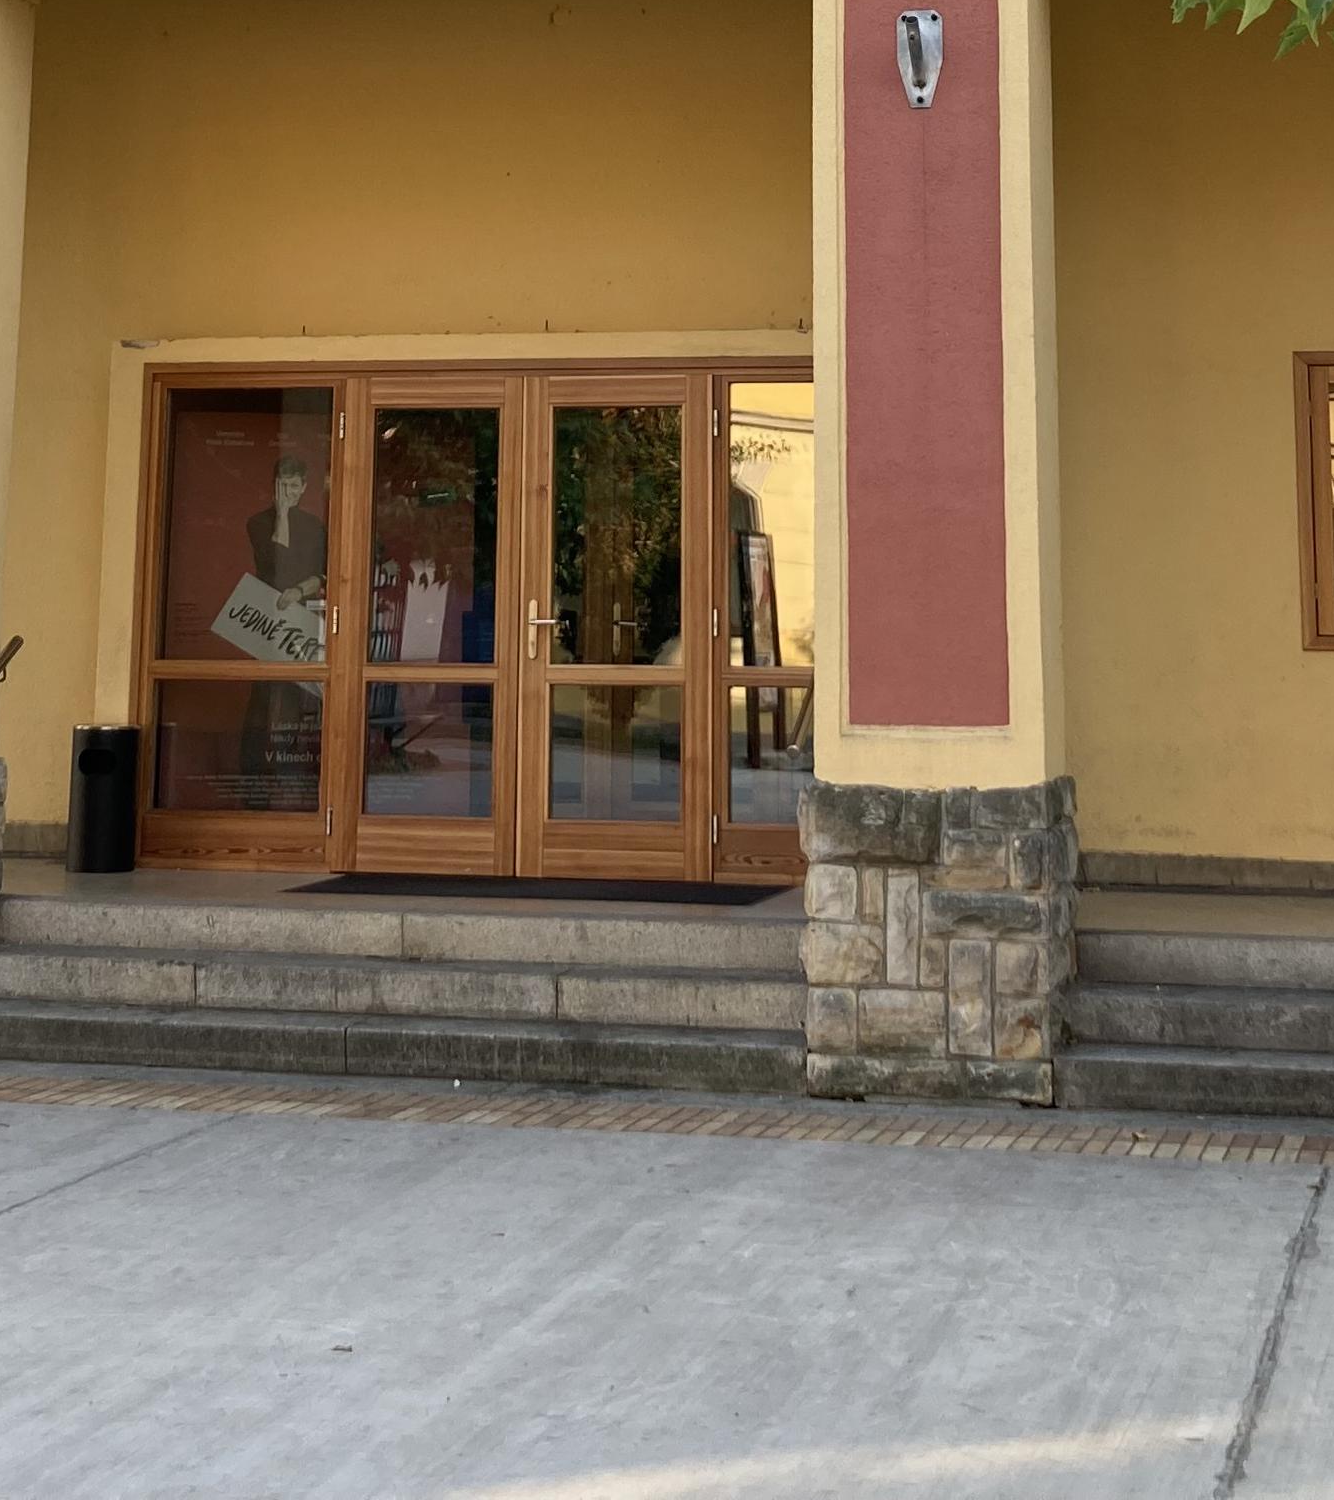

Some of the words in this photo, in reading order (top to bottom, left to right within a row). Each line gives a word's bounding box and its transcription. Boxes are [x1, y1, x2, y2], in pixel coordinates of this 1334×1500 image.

[229, 604, 287, 640] JEDINĚ
[265, 750, 274, 763] V
[276, 750, 314, 763] kinech
